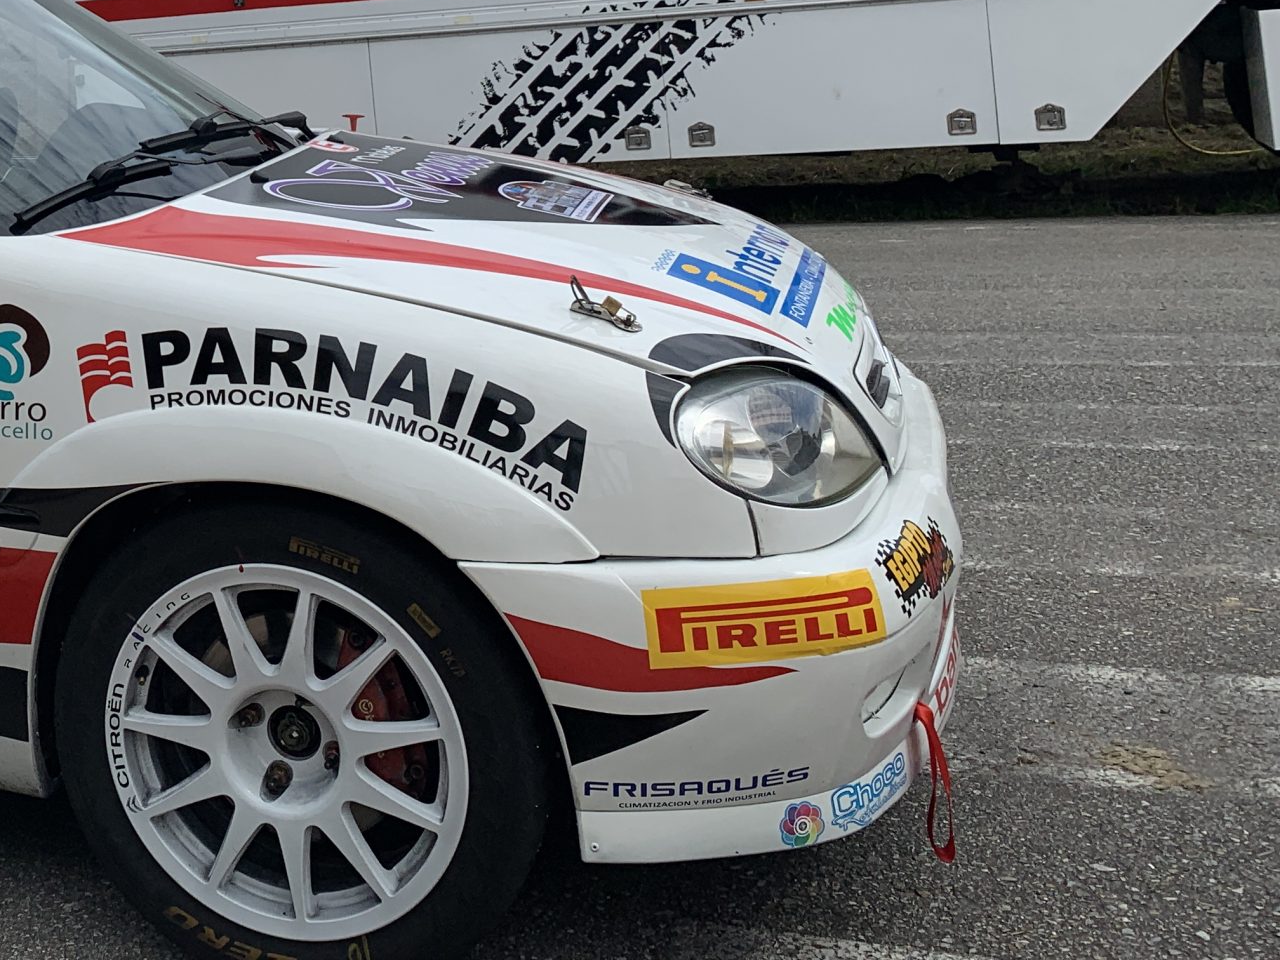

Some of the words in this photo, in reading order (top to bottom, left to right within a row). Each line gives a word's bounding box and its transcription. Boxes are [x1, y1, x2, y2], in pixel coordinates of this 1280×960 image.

[142, 326, 589, 494] PARNAIBA
[150, 388, 352, 419] PROMOCIONES
[367, 407, 576, 512] INMOBILIARIAS
[288, 536, 361, 575] PIRELLI
[886, 519, 932, 593] EGIPTO
[655, 586, 878, 654] PIRELLI
[108, 681, 132, 789] CITROËN
[583, 766, 810, 798] FRISAQUÉS
[724, 790, 777, 803] INDUSTRIAL
[831, 752, 906, 818] Choco
